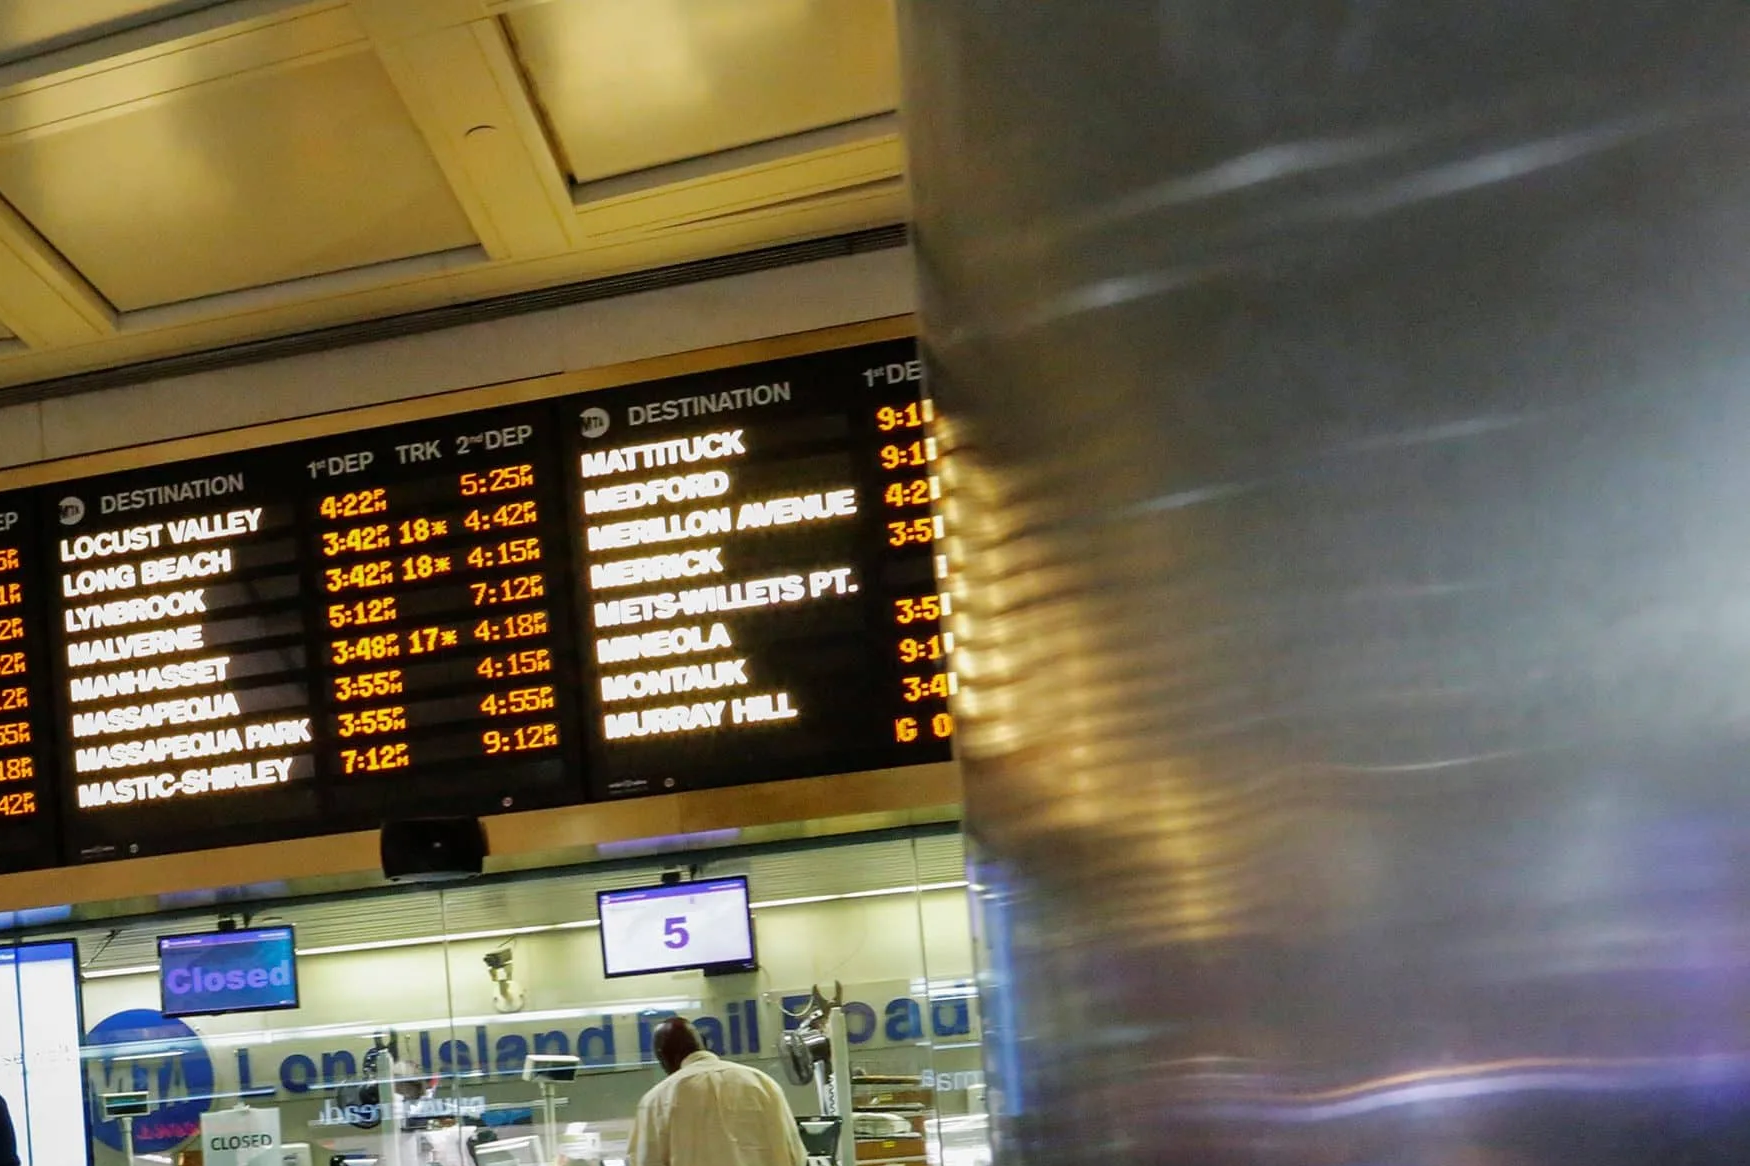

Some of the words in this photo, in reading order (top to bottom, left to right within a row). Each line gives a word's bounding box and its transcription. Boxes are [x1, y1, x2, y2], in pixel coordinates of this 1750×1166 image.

[628, 382, 790, 425] DESTINATION
[581, 430, 745, 477] MATTITUCK
[102, 474, 243, 514] DESTINATION
[396, 440, 441, 463] TRK
[584, 470, 730, 515] MEDFORD
[61, 524, 163, 562] LOCUST
[167, 508, 262, 544] VALLEY
[587, 507, 732, 552] MERILLON
[736, 489, 857, 530] AVENUE
[63, 564, 136, 597] LONG
[140, 549, 231, 585] BEACH
[590, 547, 723, 590] MERRICK
[65, 589, 206, 632] LYNBROOK
[594, 575, 805, 627] METS-WILLETS
[809, 568, 858, 598] PT.
[68, 624, 204, 667] MALVERNE
[596, 623, 732, 664] MINEOLA
[70, 656, 230, 702] MANHASSET
[600, 659, 748, 702] MONTAUK
[72, 692, 240, 737] MASSAPEQUA
[603, 700, 726, 740] MURRAY
[731, 693, 798, 724] HILL
[76, 727, 244, 772] MASSAPEQUA
[244, 718, 311, 749] PARK
[78, 757, 293, 808] MASTIC-SHIRLEY
[663, 915, 690, 949] 5
[166, 960, 291, 995] Closed
[210, 1134, 272, 1151] CLOSED
